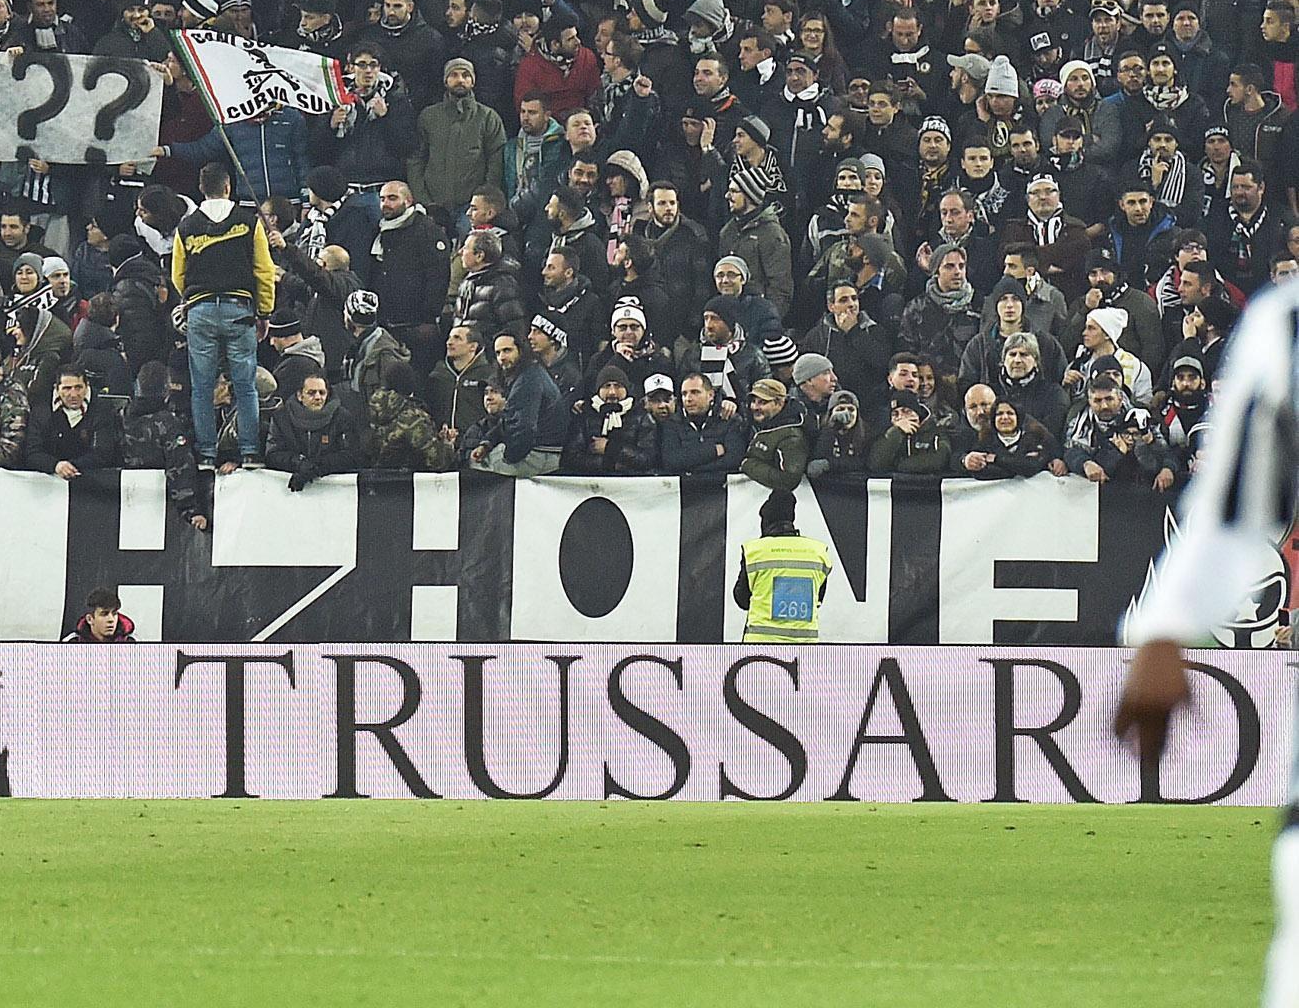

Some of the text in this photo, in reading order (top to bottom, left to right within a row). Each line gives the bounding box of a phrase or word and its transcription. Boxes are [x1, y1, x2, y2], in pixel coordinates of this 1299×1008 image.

[226, 86, 290, 119] CURVA
[778, 600, 808, 619] 269
[174, 652, 1299, 804] TRUSSARD
